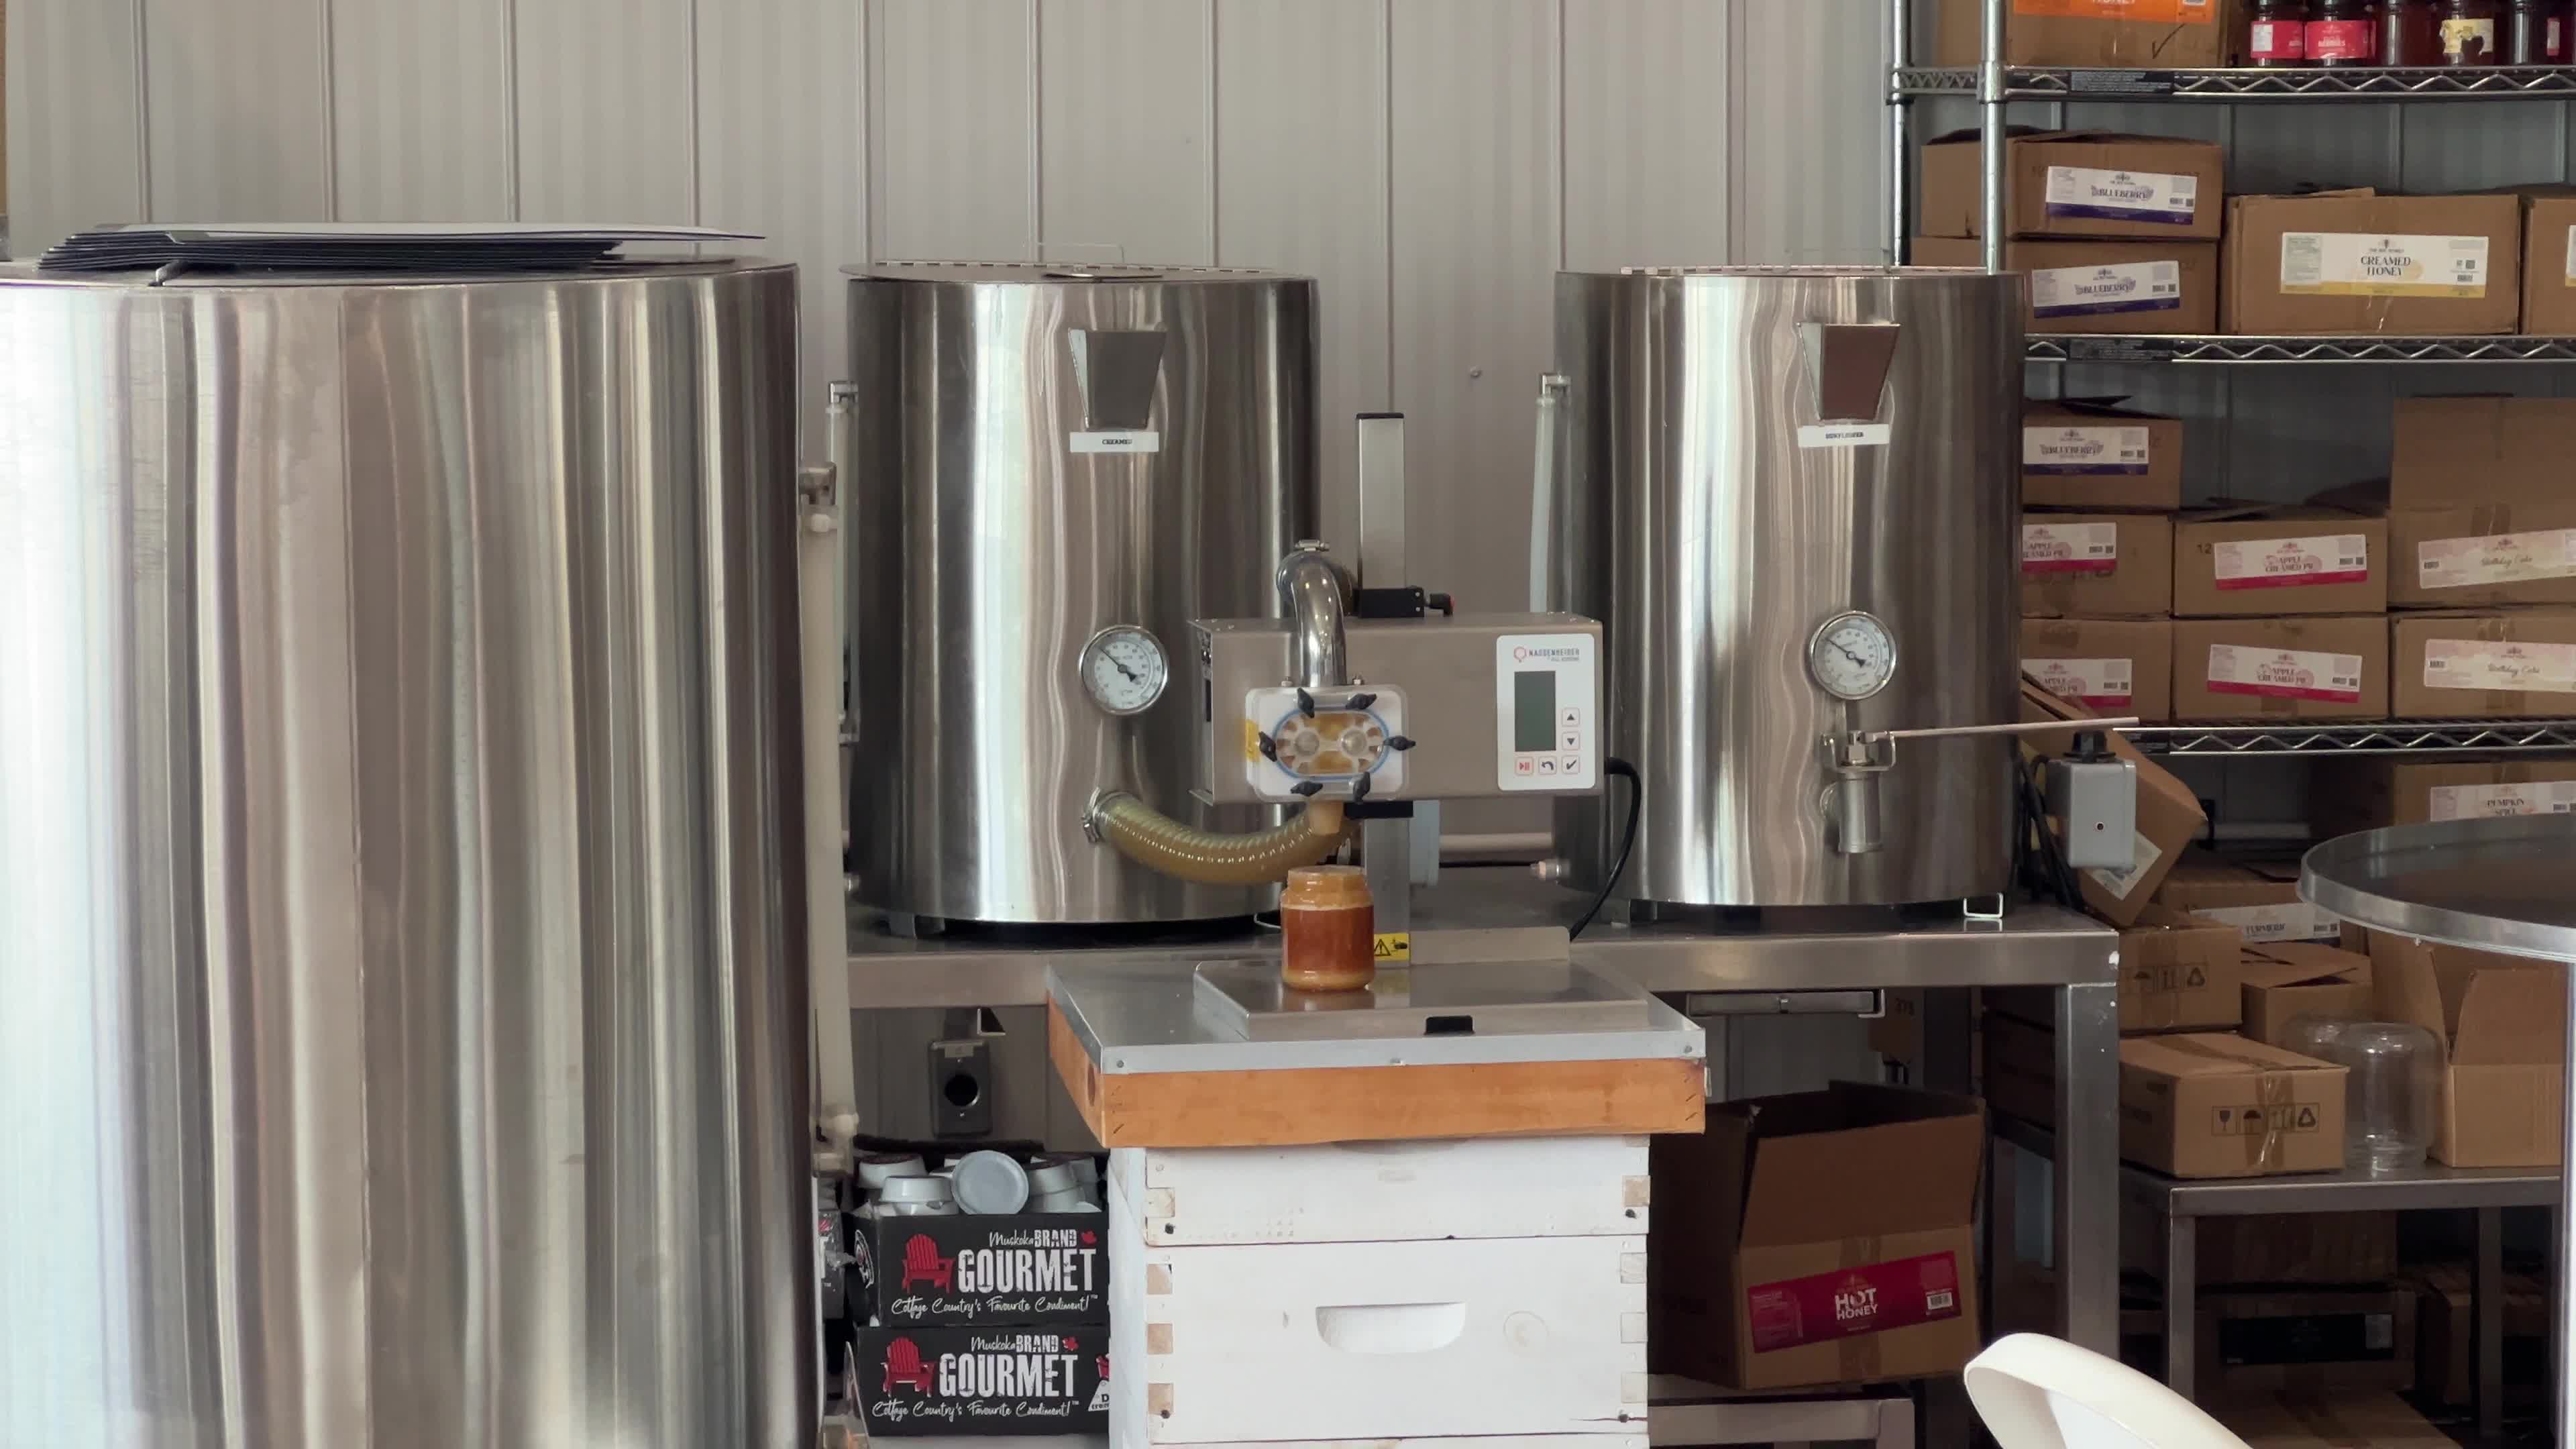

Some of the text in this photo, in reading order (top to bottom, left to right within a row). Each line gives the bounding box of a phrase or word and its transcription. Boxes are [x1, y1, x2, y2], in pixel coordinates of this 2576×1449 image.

[2360, 256, 2411, 266] CREAMED
[2367, 267, 2403, 276] HONEY
[958, 1248, 1096, 1293] GOURMET
[891, 1295, 928, 1319] Cottage
[932, 1297, 981, 1319] Country's
[986, 1295, 1031, 1313] Favourite
[1835, 1287, 1877, 1311] HOT
[1836, 1303, 1878, 1321] HONEY
[939, 1353, 1078, 1397] GOURMET
[872, 1398, 909, 1421] Cottage
[912, 1401, 963, 1422] Country's
[967, 1399, 1011, 1417] Favourite
